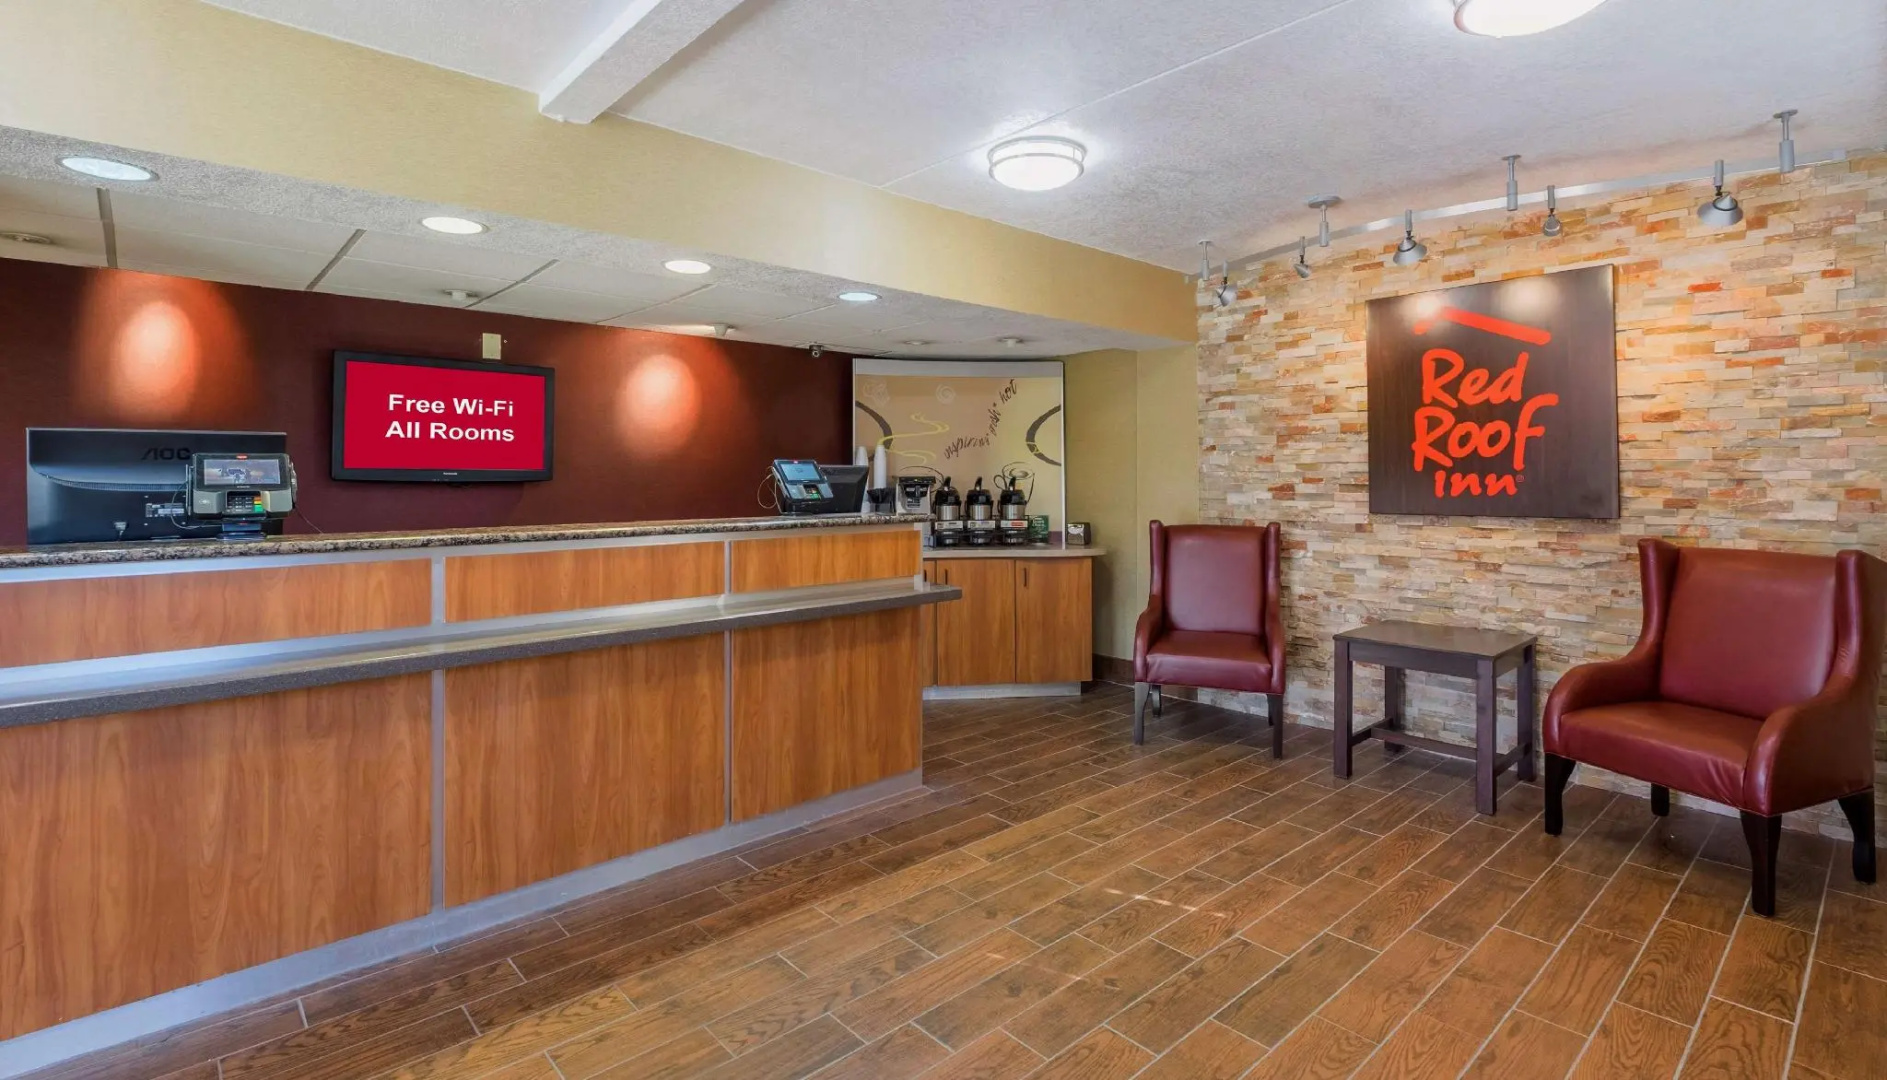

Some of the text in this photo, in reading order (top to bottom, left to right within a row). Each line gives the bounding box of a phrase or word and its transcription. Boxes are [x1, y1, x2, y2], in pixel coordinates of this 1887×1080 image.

[1421, 348, 1529, 408] Red
[388, 393, 513, 417] Free Wi-Fi
[385, 420, 515, 442] All Rooms
[1411, 393, 1559, 471] Roof
[141, 447, 192, 461] AOC
